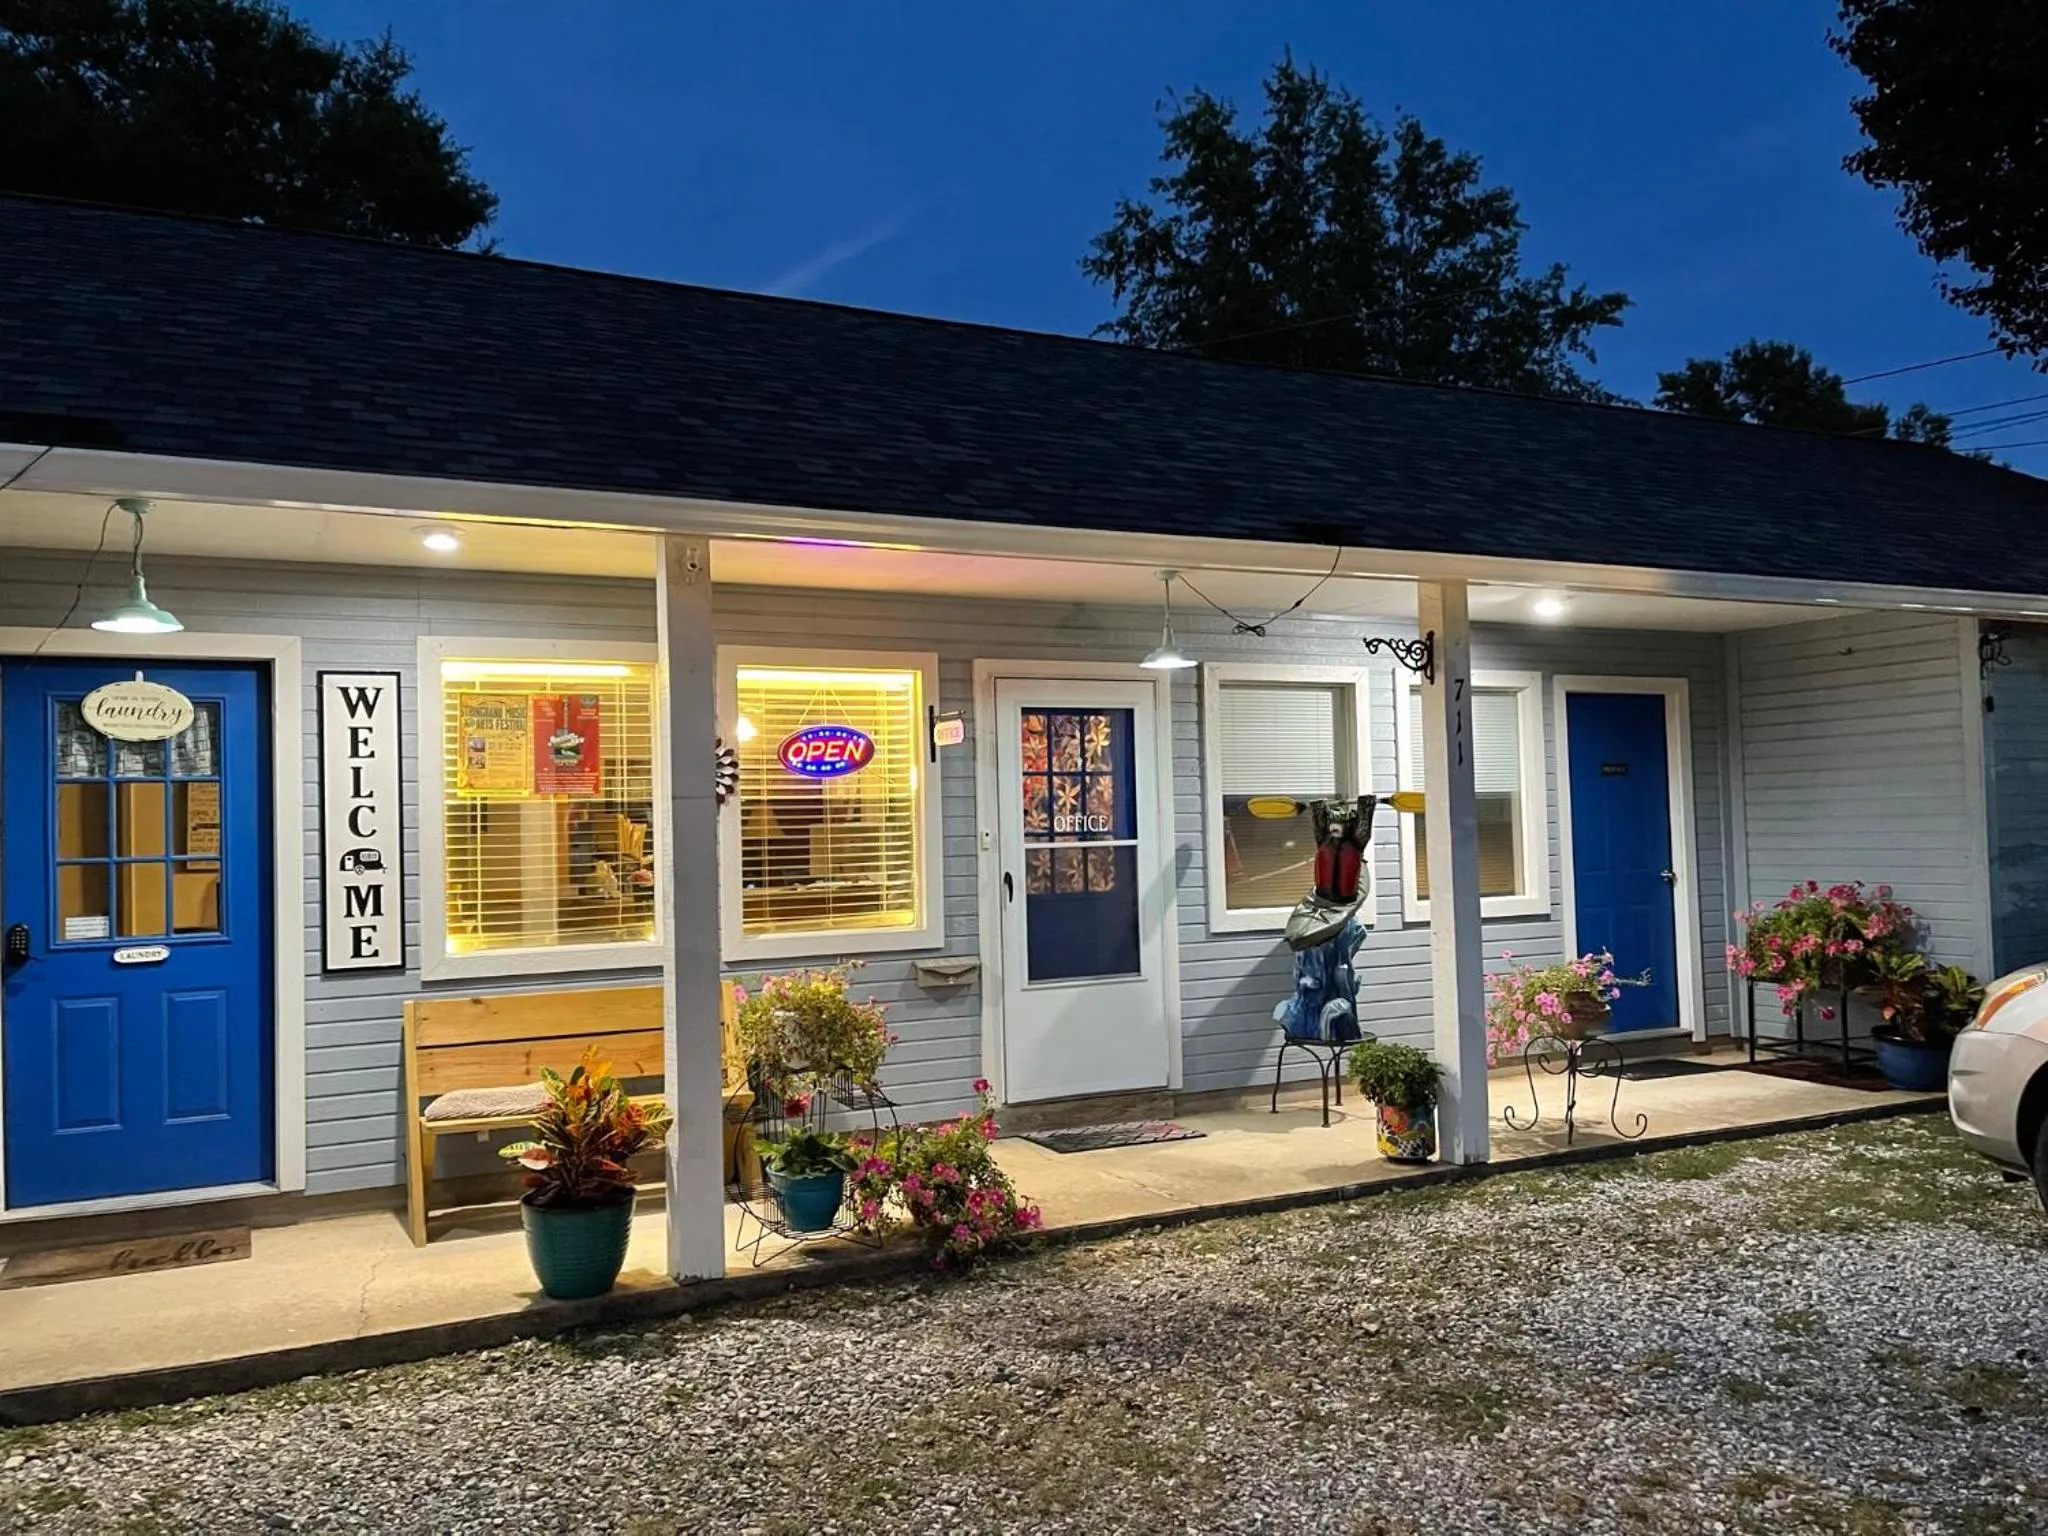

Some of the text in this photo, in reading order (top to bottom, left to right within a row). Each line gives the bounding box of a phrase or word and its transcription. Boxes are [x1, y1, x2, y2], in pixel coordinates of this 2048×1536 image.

[96, 697, 182, 725] laundry
[787, 738, 866, 763] OPEN
[1053, 814, 1109, 833] OFFICE
[120, 950, 163, 960] LAUNDRY
